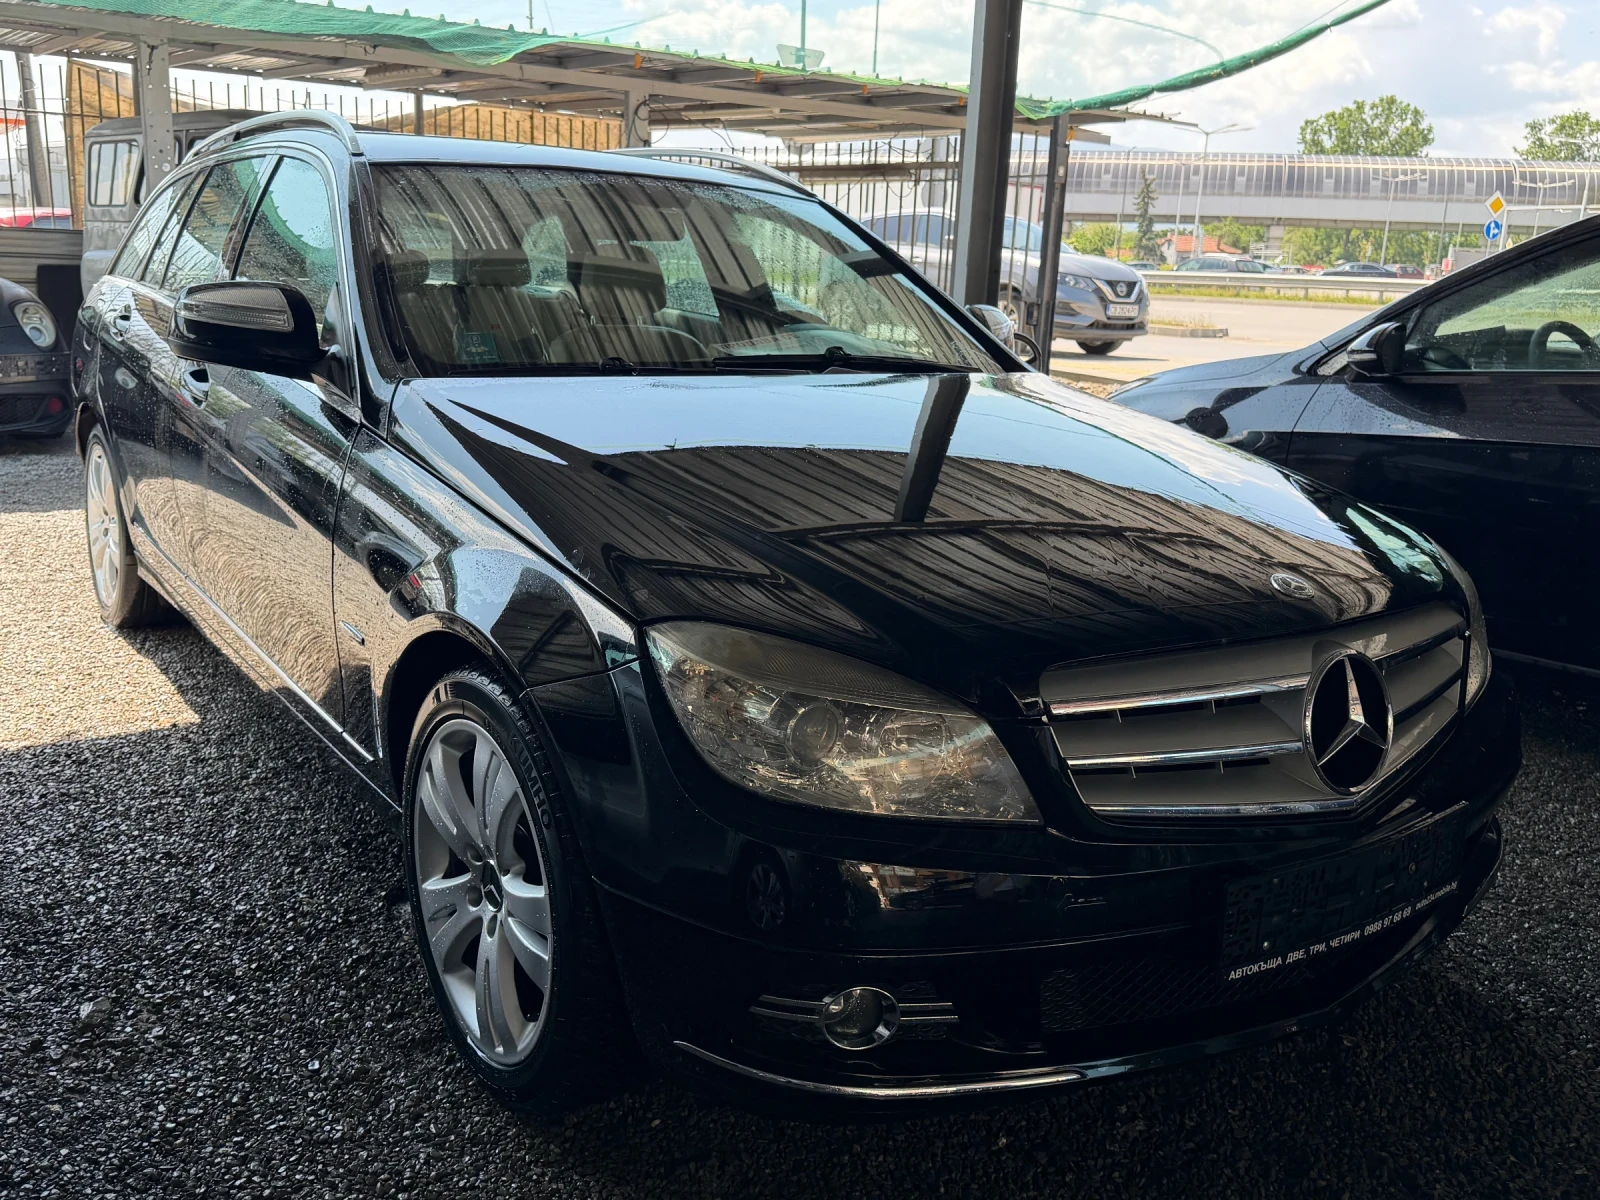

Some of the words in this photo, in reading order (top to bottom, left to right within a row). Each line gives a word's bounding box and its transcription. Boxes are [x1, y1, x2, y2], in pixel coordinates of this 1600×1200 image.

[508, 730, 552, 830] KUMHO
[1228, 956, 1283, 981] АВТОКЪЩА
[1285, 949, 1307, 965] ДВЕ,
[1309, 942, 1327, 956] ТРИ,
[1329, 929, 1361, 948] ЧЕТИРИ
[1364, 920, 1383, 936] 0988
[1383, 915, 1393, 928] 97
[1393, 911, 1402, 923] 68
